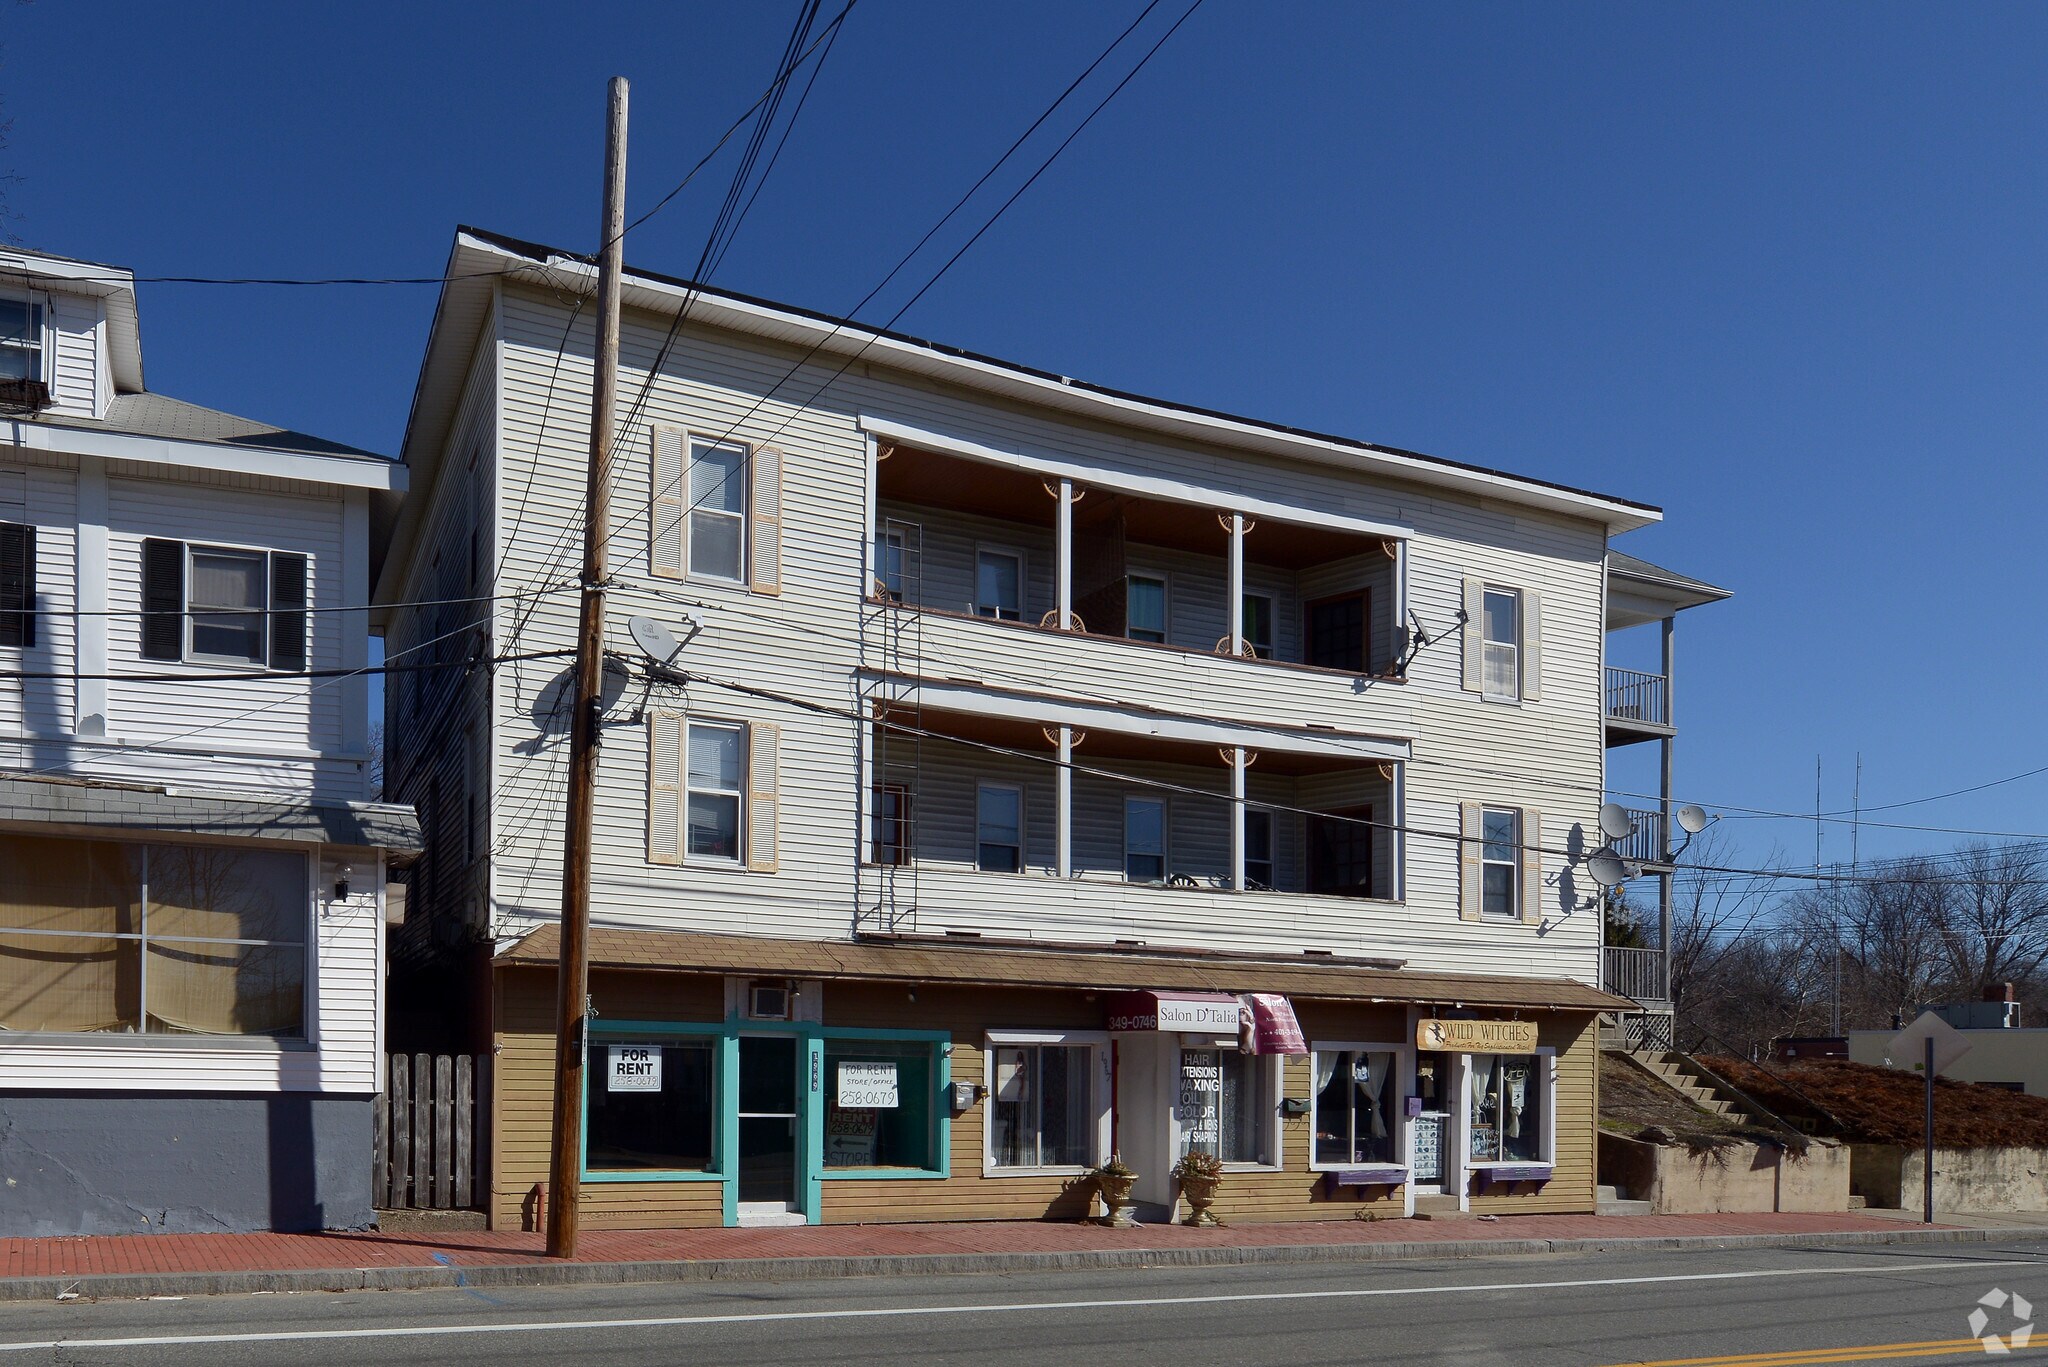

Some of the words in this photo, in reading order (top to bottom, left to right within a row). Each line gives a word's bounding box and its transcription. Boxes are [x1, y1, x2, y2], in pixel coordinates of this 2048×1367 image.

[1109, 1015, 1157, 1029] 349-0746
[1161, 1008, 1192, 1022] Salon
[1197, 1008, 1237, 1024] D'Talia
[1446, 1023, 1473, 1039] WILD
[1481, 1024, 1529, 1041] WITCHES
[622, 1049, 648, 1061] FOR
[1185, 1054, 1209, 1066] HAIR
[617, 1063, 653, 1075] RENT
[846, 1065, 862, 1075] FOR
[867, 1065, 893, 1075] RENT
[1181, 1066, 1217, 1078] XTENSIONS
[1182, 1092, 1200, 1104] OIL
[832, 1112, 873, 1123] RENT
[1181, 1131, 1191, 1142] AIR
[1193, 1131, 1217, 1143] SHAPING
